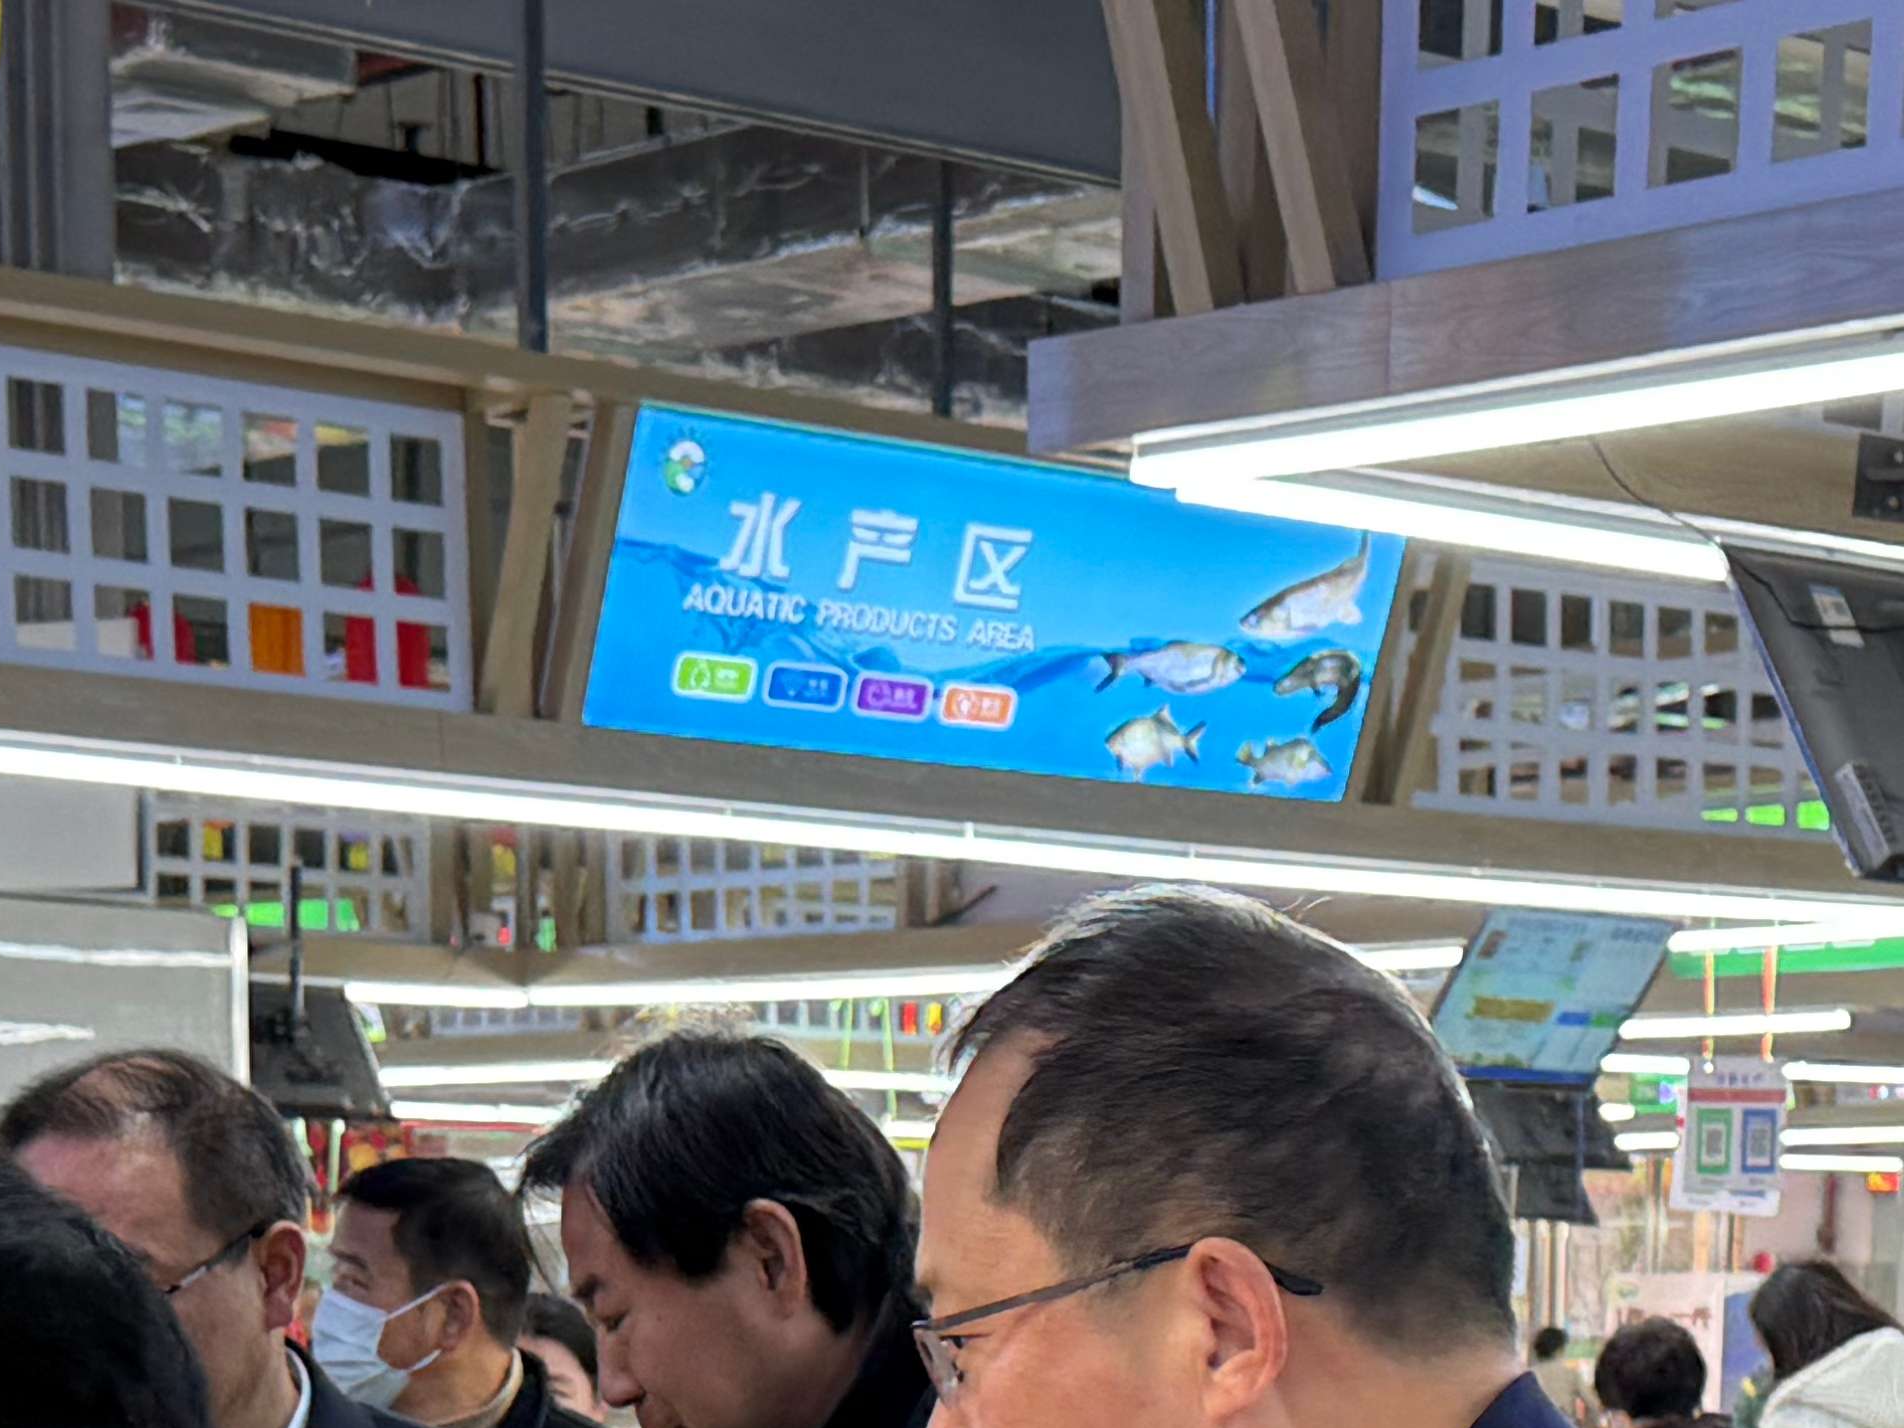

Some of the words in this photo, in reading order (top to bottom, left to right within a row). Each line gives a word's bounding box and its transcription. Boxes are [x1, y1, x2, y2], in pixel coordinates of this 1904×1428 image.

[718, 491, 1034, 613] 水产区
[683, 582, 809, 624] AQUATIC
[815, 599, 959, 642] PRODUCTS
[967, 617, 1036, 652] AREA
